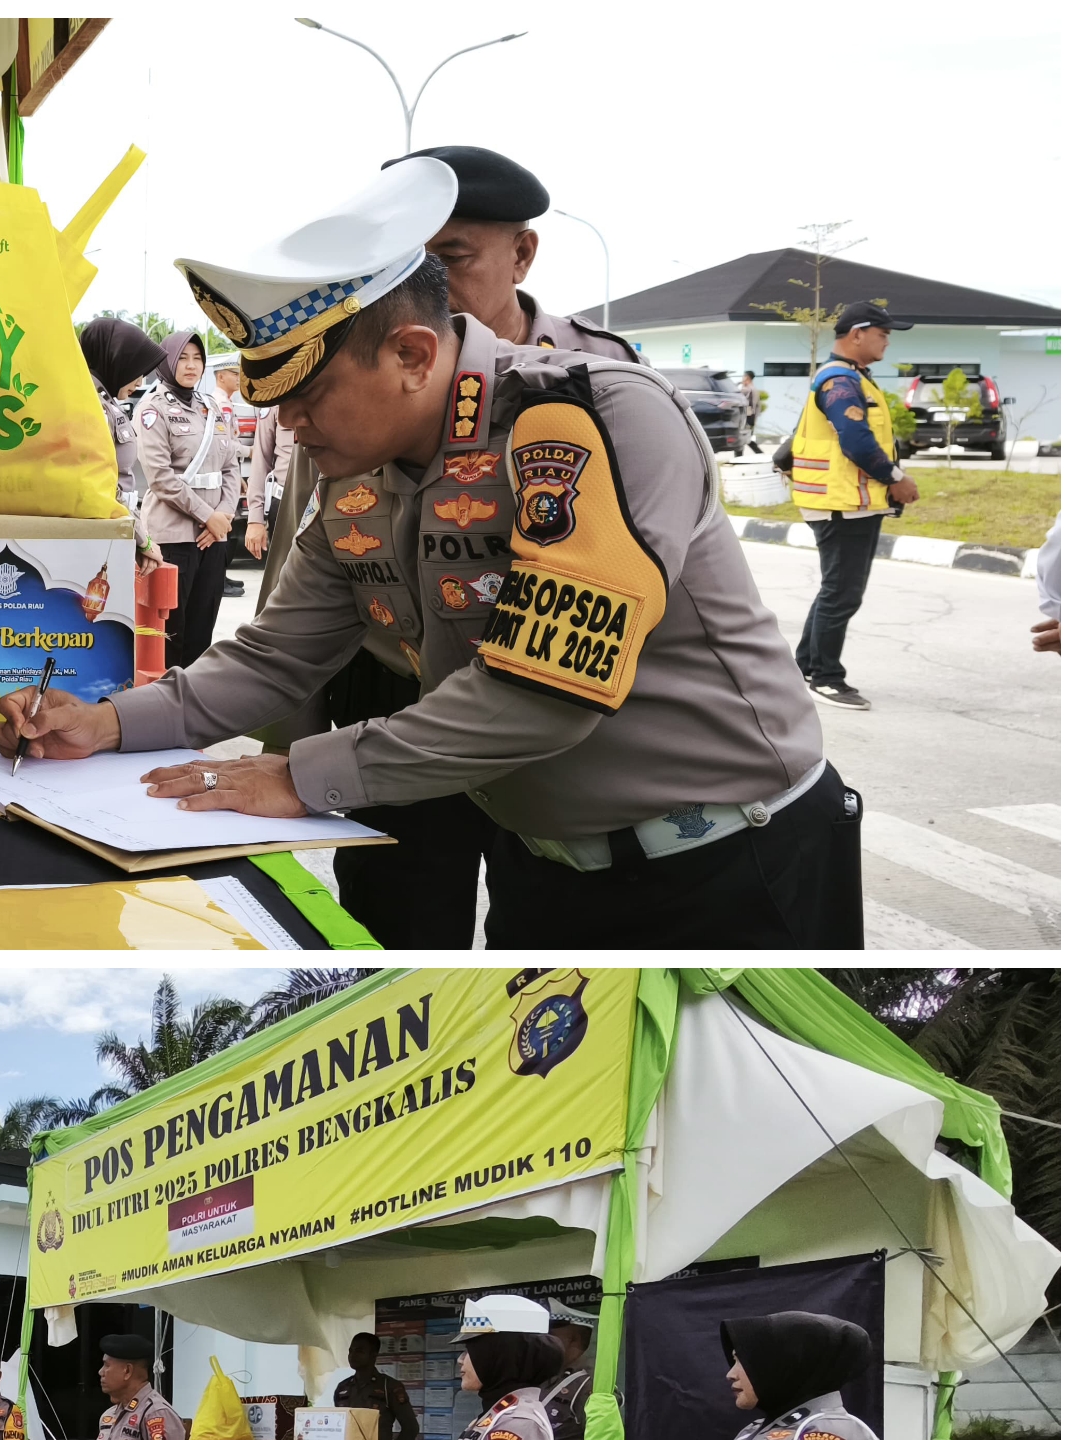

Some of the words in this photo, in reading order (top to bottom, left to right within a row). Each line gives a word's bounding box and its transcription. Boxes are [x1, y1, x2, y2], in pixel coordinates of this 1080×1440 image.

[522, 448, 576, 464] POLDA
[524, 467, 572, 481] RIAU
[525, 620, 559, 662] LK
[558, 630, 620, 682] 2025
[83, 1138, 134, 1195] POS
[142, 992, 434, 1168] PENGAMANAN
[72, 1204, 104, 1235] IDUL
[107, 1188, 150, 1219] FITRI
[154, 1171, 198, 1206] 2025
[203, 1132, 290, 1190] POLRES
[297, 1057, 479, 1157] BENGKALIS
[121, 1263, 159, 1283] #MUDIK
[161, 1254, 194, 1272] AMAN
[196, 1235, 266, 1265] KELUARGA
[269, 1215, 336, 1246] NYAMAN
[349, 1180, 447, 1225] #HOTLINE
[454, 1153, 535, 1194] MUDIK
[543, 1137, 592, 1167] 110
[181, 1212, 207, 1226] POLRI
[207, 1200, 237, 1218] UNTUK
[181, 1214, 238, 1237] MASYARAKAT
[399, 1298, 427, 1309] PANEL
[533, 1280, 593, 1295] LANCANG
